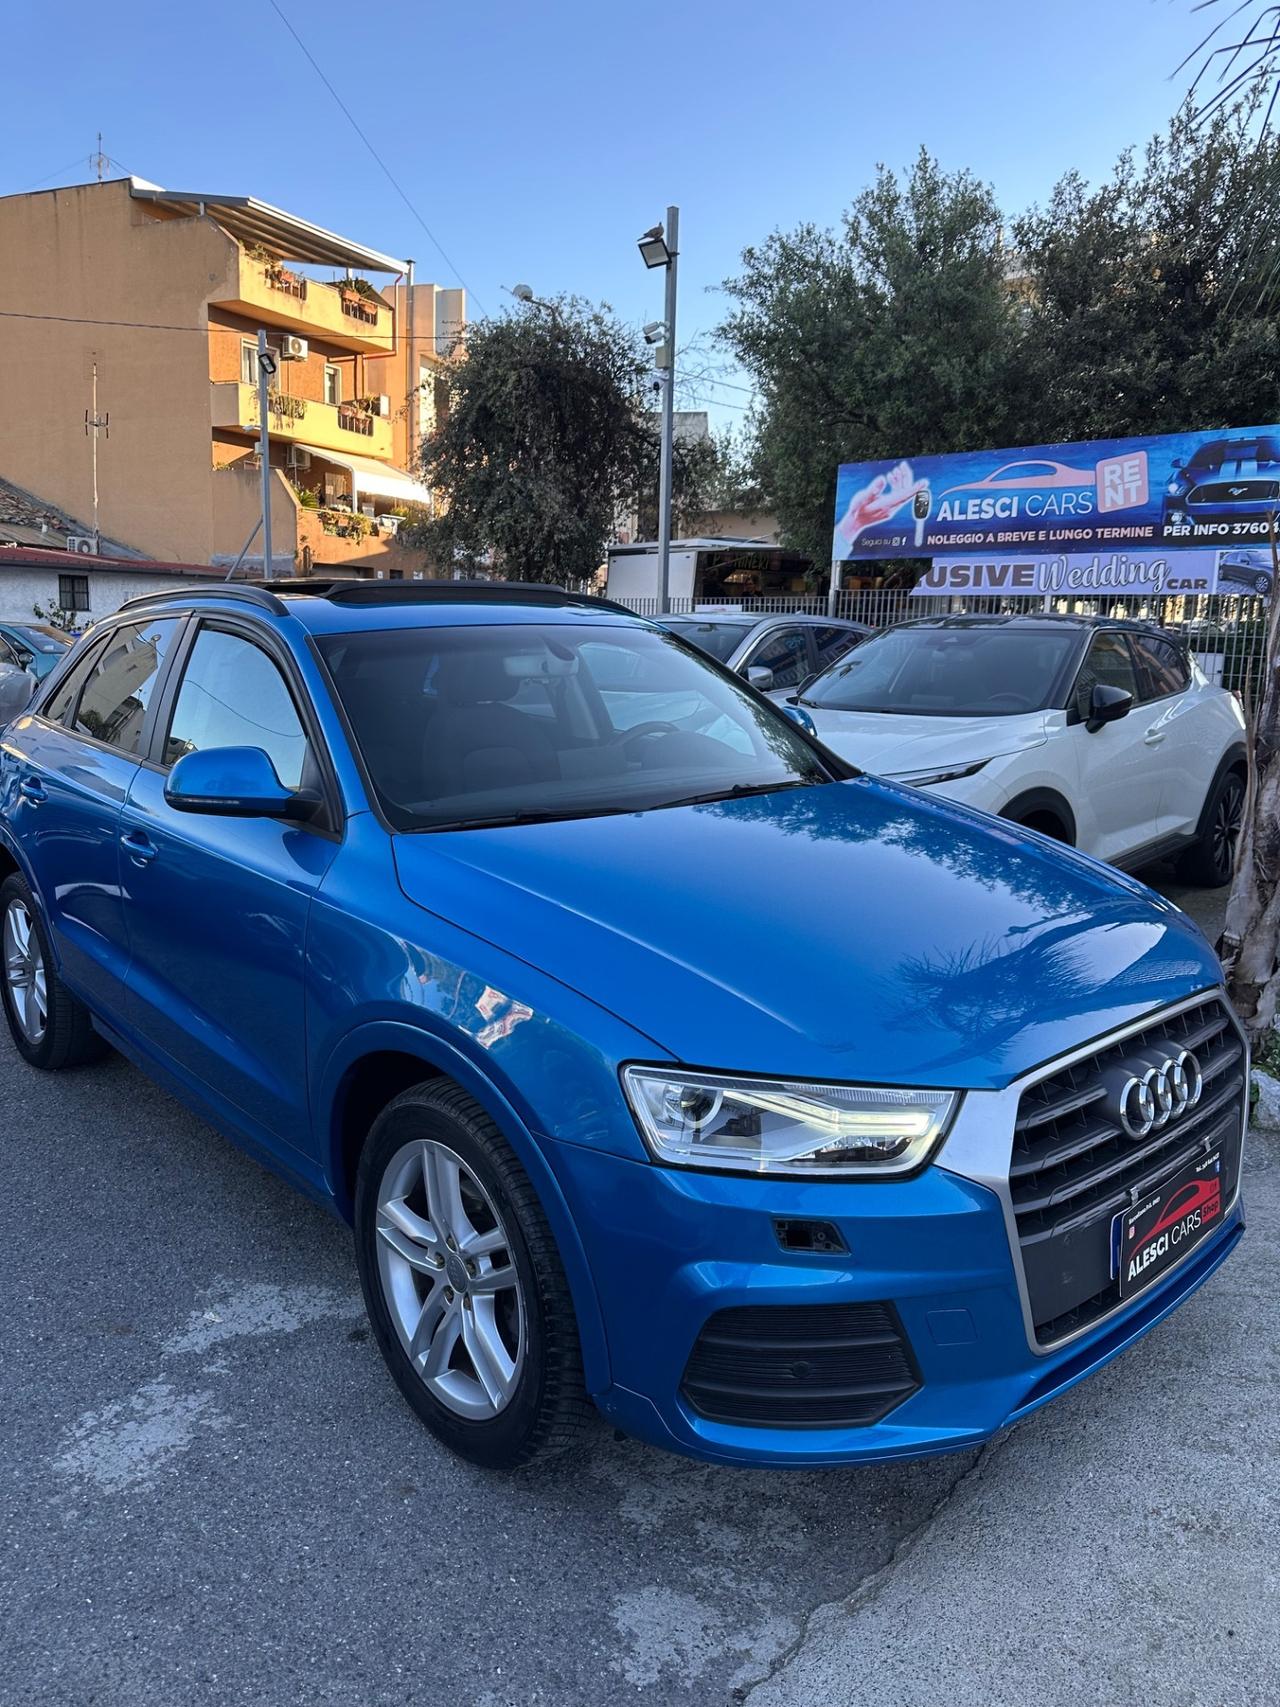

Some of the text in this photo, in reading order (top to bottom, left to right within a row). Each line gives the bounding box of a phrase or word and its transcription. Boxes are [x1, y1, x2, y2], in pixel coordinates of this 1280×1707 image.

[937, 491, 1093, 521] ALESCI CARS
[927, 526, 1154, 545] NOLEGGIO A BREVE E LUNGO TERMINE
[1163, 525, 1190, 536] PER
[1194, 523, 1229, 535] INFO
[1038, 555, 1171, 593] Wedding
[1167, 578, 1208, 590] CAR
[1127, 1233, 1169, 1282] ALESCI
[1171, 1209, 1201, 1245] CARS
